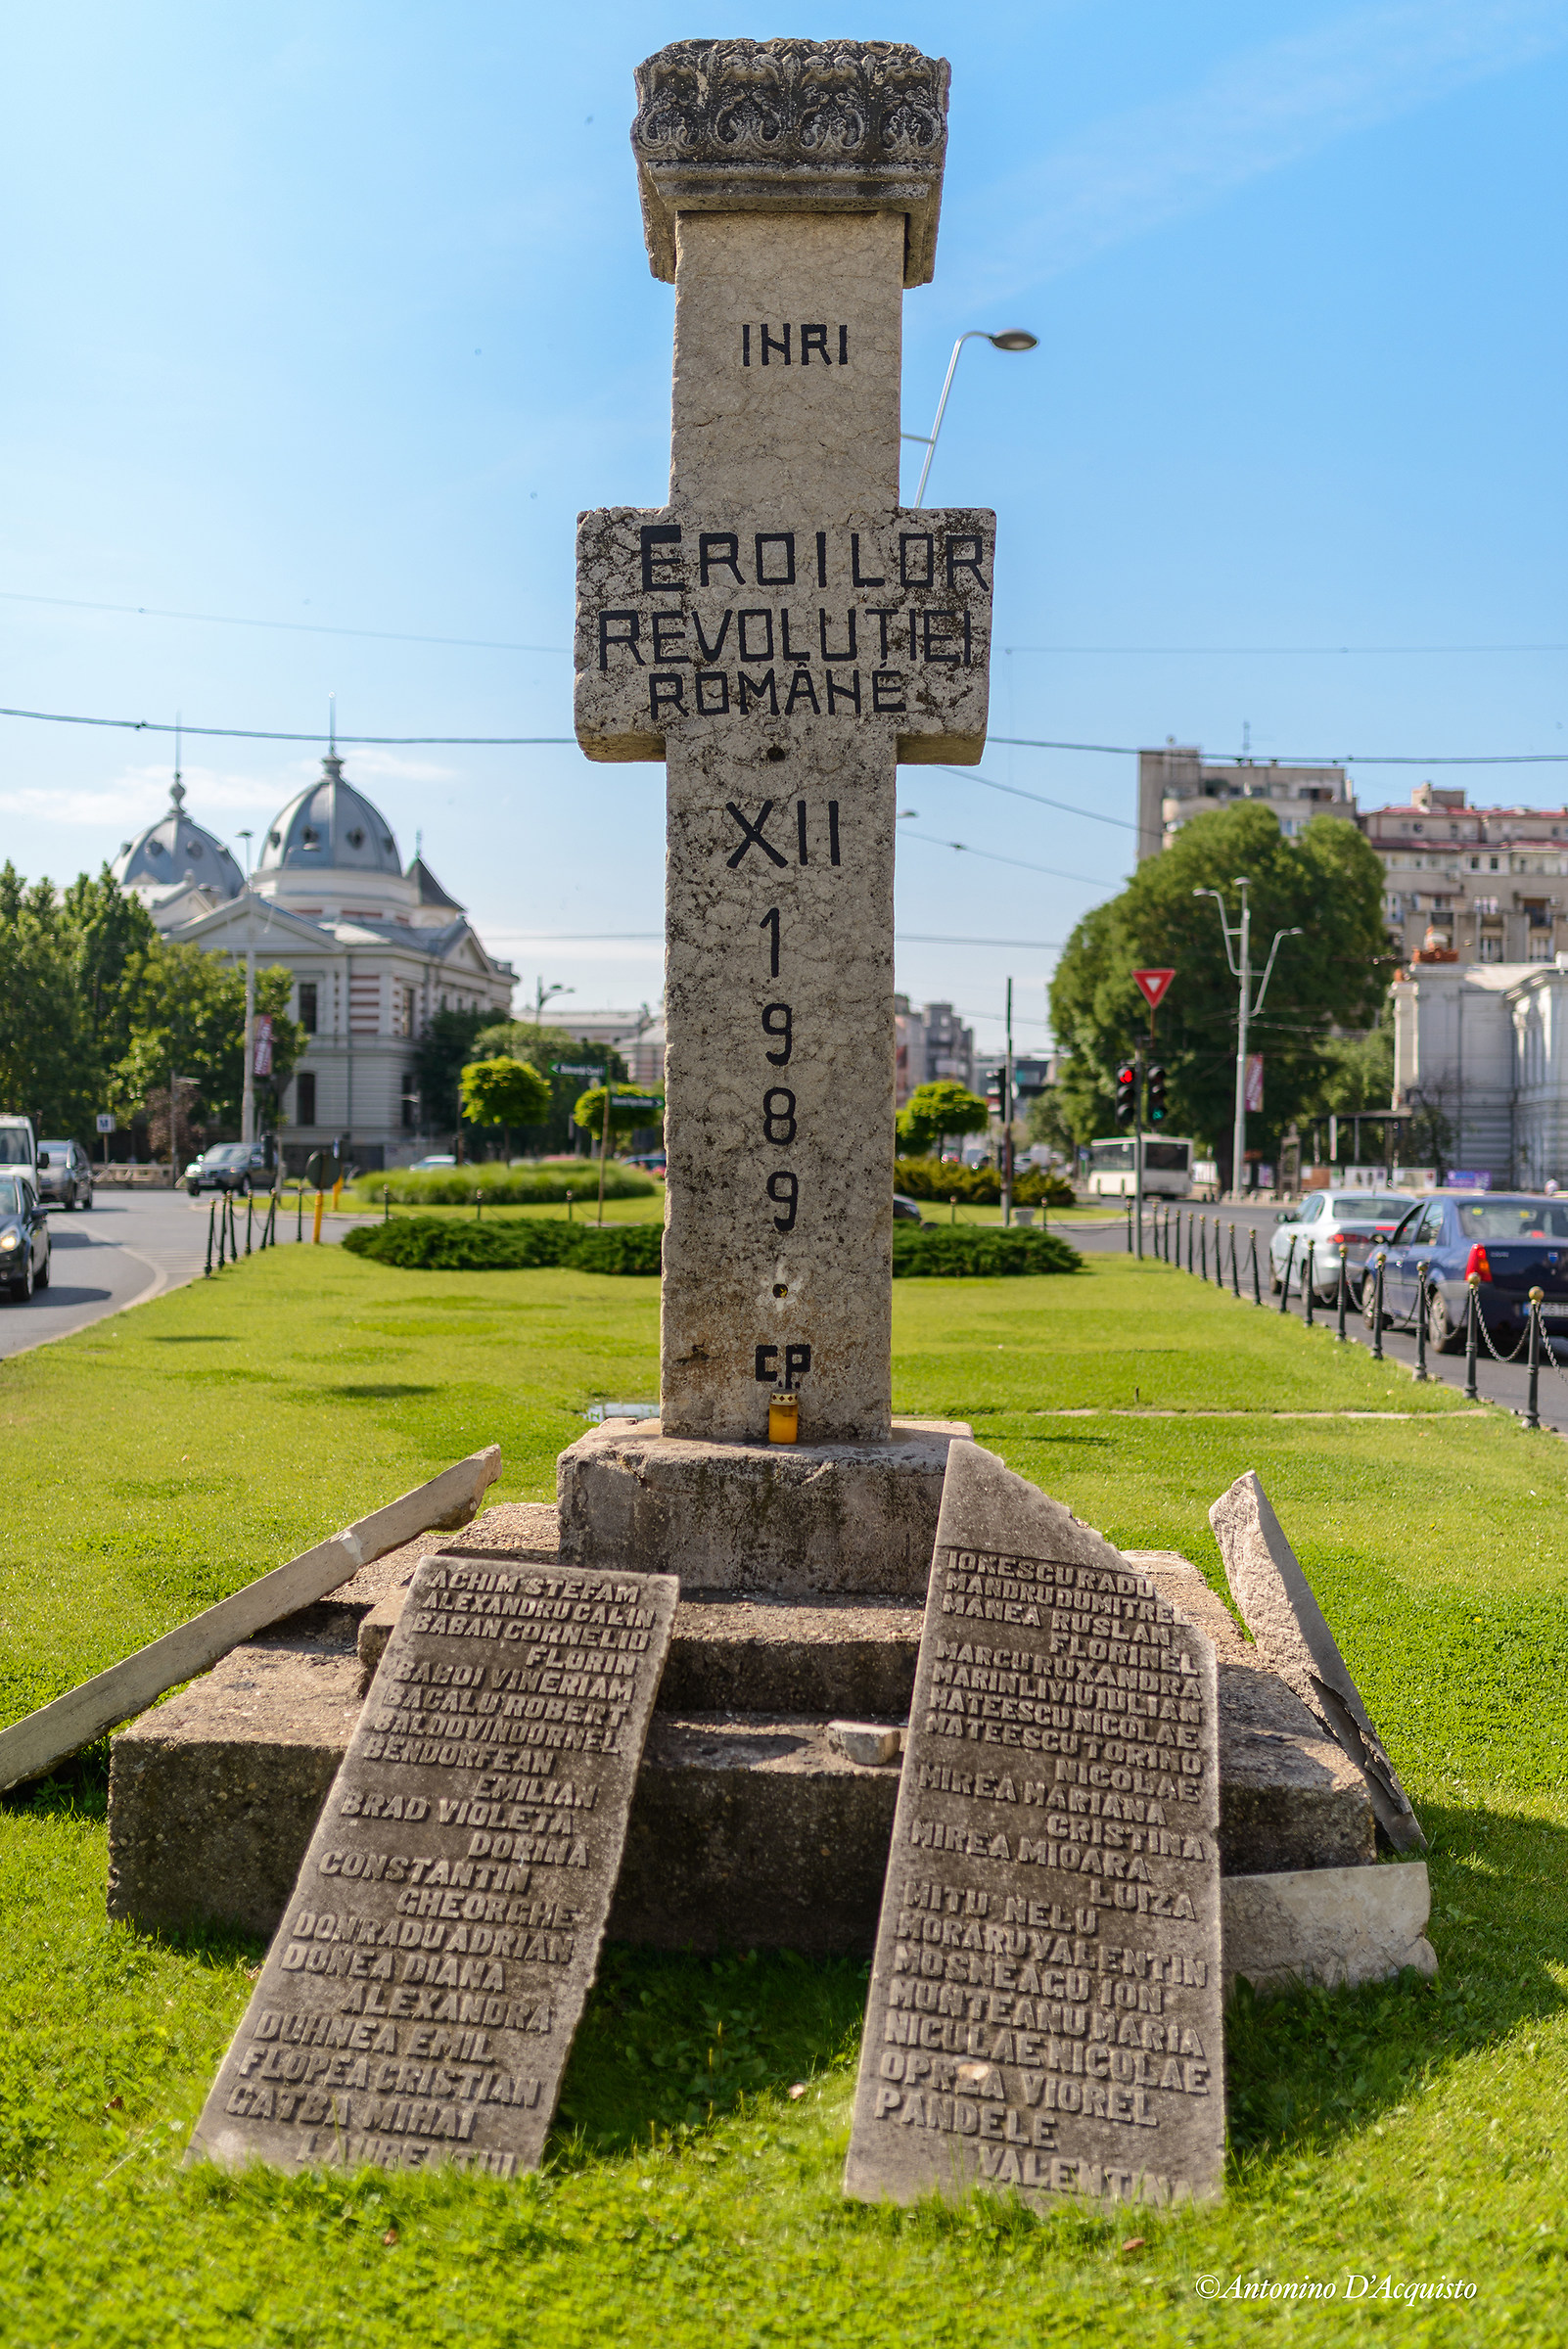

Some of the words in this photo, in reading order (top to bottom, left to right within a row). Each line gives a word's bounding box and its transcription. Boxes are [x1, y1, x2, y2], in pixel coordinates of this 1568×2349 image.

[742, 323, 848, 367] INRI
[640, 525, 989, 591] EROILOR
[648, 661, 906, 720] ROMÂNE
[726, 800, 840, 869] XII
[760, 907, 799, 1232] 1989
[431, 1569, 517, 1595] ACHIM
[945, 1573, 1054, 1606] MANDRU
[1055, 1589, 1191, 1627] DUMITREL
[946, 1550, 1076, 1587] IONESCU
[1077, 1568, 1155, 1600] RADU
[411, 1613, 502, 1639] BABAN
[422, 1591, 571, 1621] ALEXANDRU
[573, 1602, 656, 1630] CALIN
[942, 1593, 1041, 1628] MANEA
[1051, 1609, 1173, 1647] RUSLAN
[526, 1645, 638, 1677] FLORIN
[937, 1639, 1029, 1672] MARCU
[1034, 1654, 1202, 1702] RUXANDRA
[1049, 1632, 1202, 1677] FLORINEL
[383, 1684, 504, 1716] BACALU
[504, 1696, 628, 1728] ROBERT
[930, 1687, 1072, 1729] MATEESCU
[1075, 1710, 1199, 1750] NICOLAE
[927, 1713, 1078, 1757] MATEESCU
[1083, 1736, 1203, 1775] TORINO
[476, 1775, 599, 1810] EMILIAN
[918, 1764, 1017, 1803] MIREA
[1024, 1779, 1167, 1826] MARIANA
[1054, 1759, 1201, 1803] NICOLAE
[341, 1790, 431, 1821] BRAD
[438, 1798, 576, 1836] VIOLETA
[1046, 1813, 1205, 1862] CRISTINA
[319, 1850, 531, 1894] CONSTANTIN
[468, 1832, 590, 1868] DORINA
[910, 1817, 1011, 1861] MIREA
[1018, 1835, 1150, 1883] MIOARA
[395, 1890, 579, 1931] GHEORGHE
[903, 1879, 991, 1918] MITU
[1005, 1897, 1098, 1936] NELU
[1089, 1878, 1197, 1922] LUIZA
[280, 1943, 393, 1983] DONEA
[402, 1956, 507, 1993] DIANA
[445, 1927, 576, 1965] ADRIAN
[896, 1911, 1029, 1958] MORARU
[1029, 1933, 1209, 1989] VALENTIN
[895, 1944, 1091, 2003] MOSNEAGU
[1101, 1978, 1164, 2014] ION
[341, 1985, 555, 2035] ALEXANDRA
[890, 1977, 1088, 2038] MUNTEANU
[1087, 2011, 1206, 2058] MARIA
[253, 2010, 399, 2055] DUHNEA
[406, 2028, 495, 2064] EMIL
[885, 2009, 1043, 2068] NICULAE
[1047, 2036, 1210, 2095] NICOLAE
[374, 2061, 542, 2110] CRISTIAN
[1021, 2073, 1159, 2127] VIOREL
[363, 2097, 478, 2142] MIHAI
[874, 2088, 1057, 2150] PANDELE
